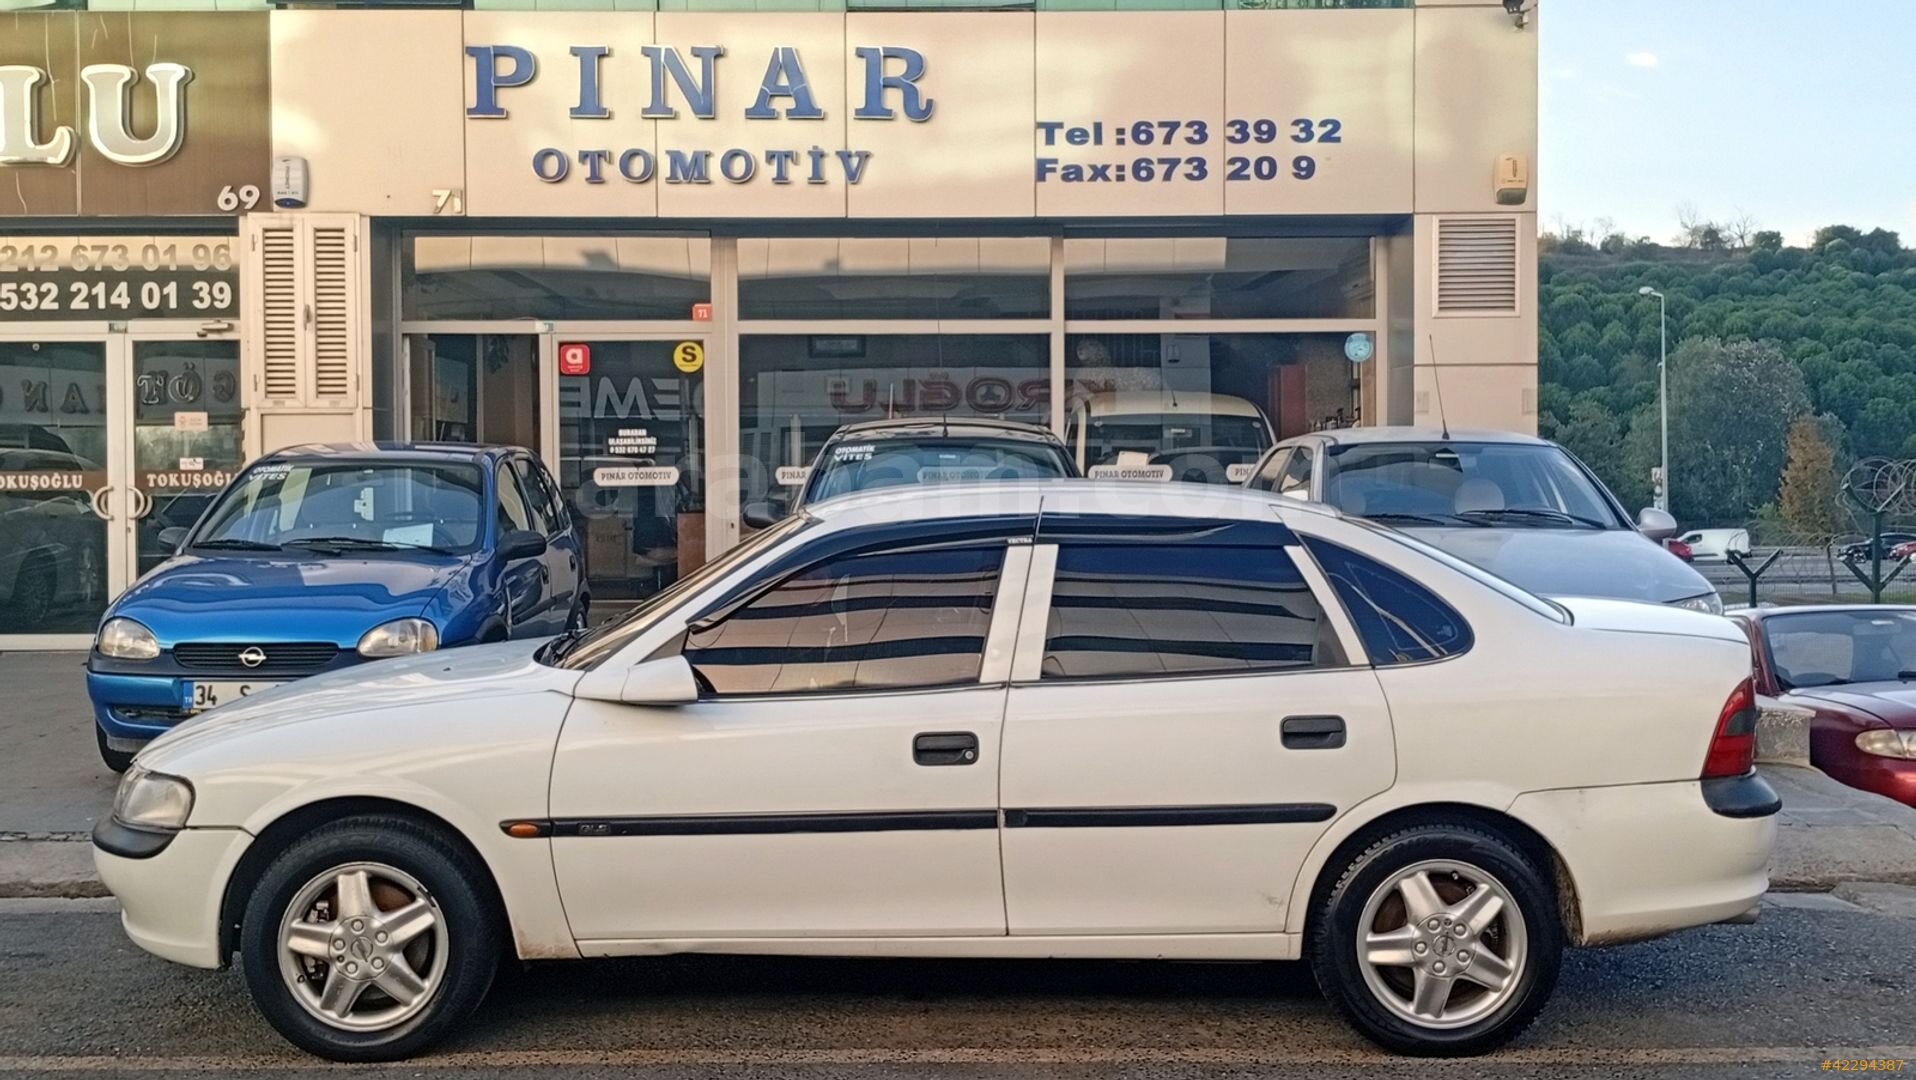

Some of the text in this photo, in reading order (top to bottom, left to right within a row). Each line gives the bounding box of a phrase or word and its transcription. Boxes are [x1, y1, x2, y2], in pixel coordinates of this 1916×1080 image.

[465, 45, 936, 122] PINAR
[0, 63, 194, 167] LU
[1036, 121, 1103, 146] Tel
[1226, 119, 1277, 144] 39
[1290, 118, 1342, 143] 32
[532, 146, 872, 184] OTOMOTİV
[1226, 156, 1278, 181] 20
[1292, 156, 1316, 180] 9
[217, 184, 261, 211] 69
[0, 243, 232, 272] 212 673 01 96
[0, 281, 232, 311] 532 214 01 39
[681, 345, 696, 363] S
[146, 470, 238, 489] TOKUŞOĞL
[195, 685, 217, 706] 34
